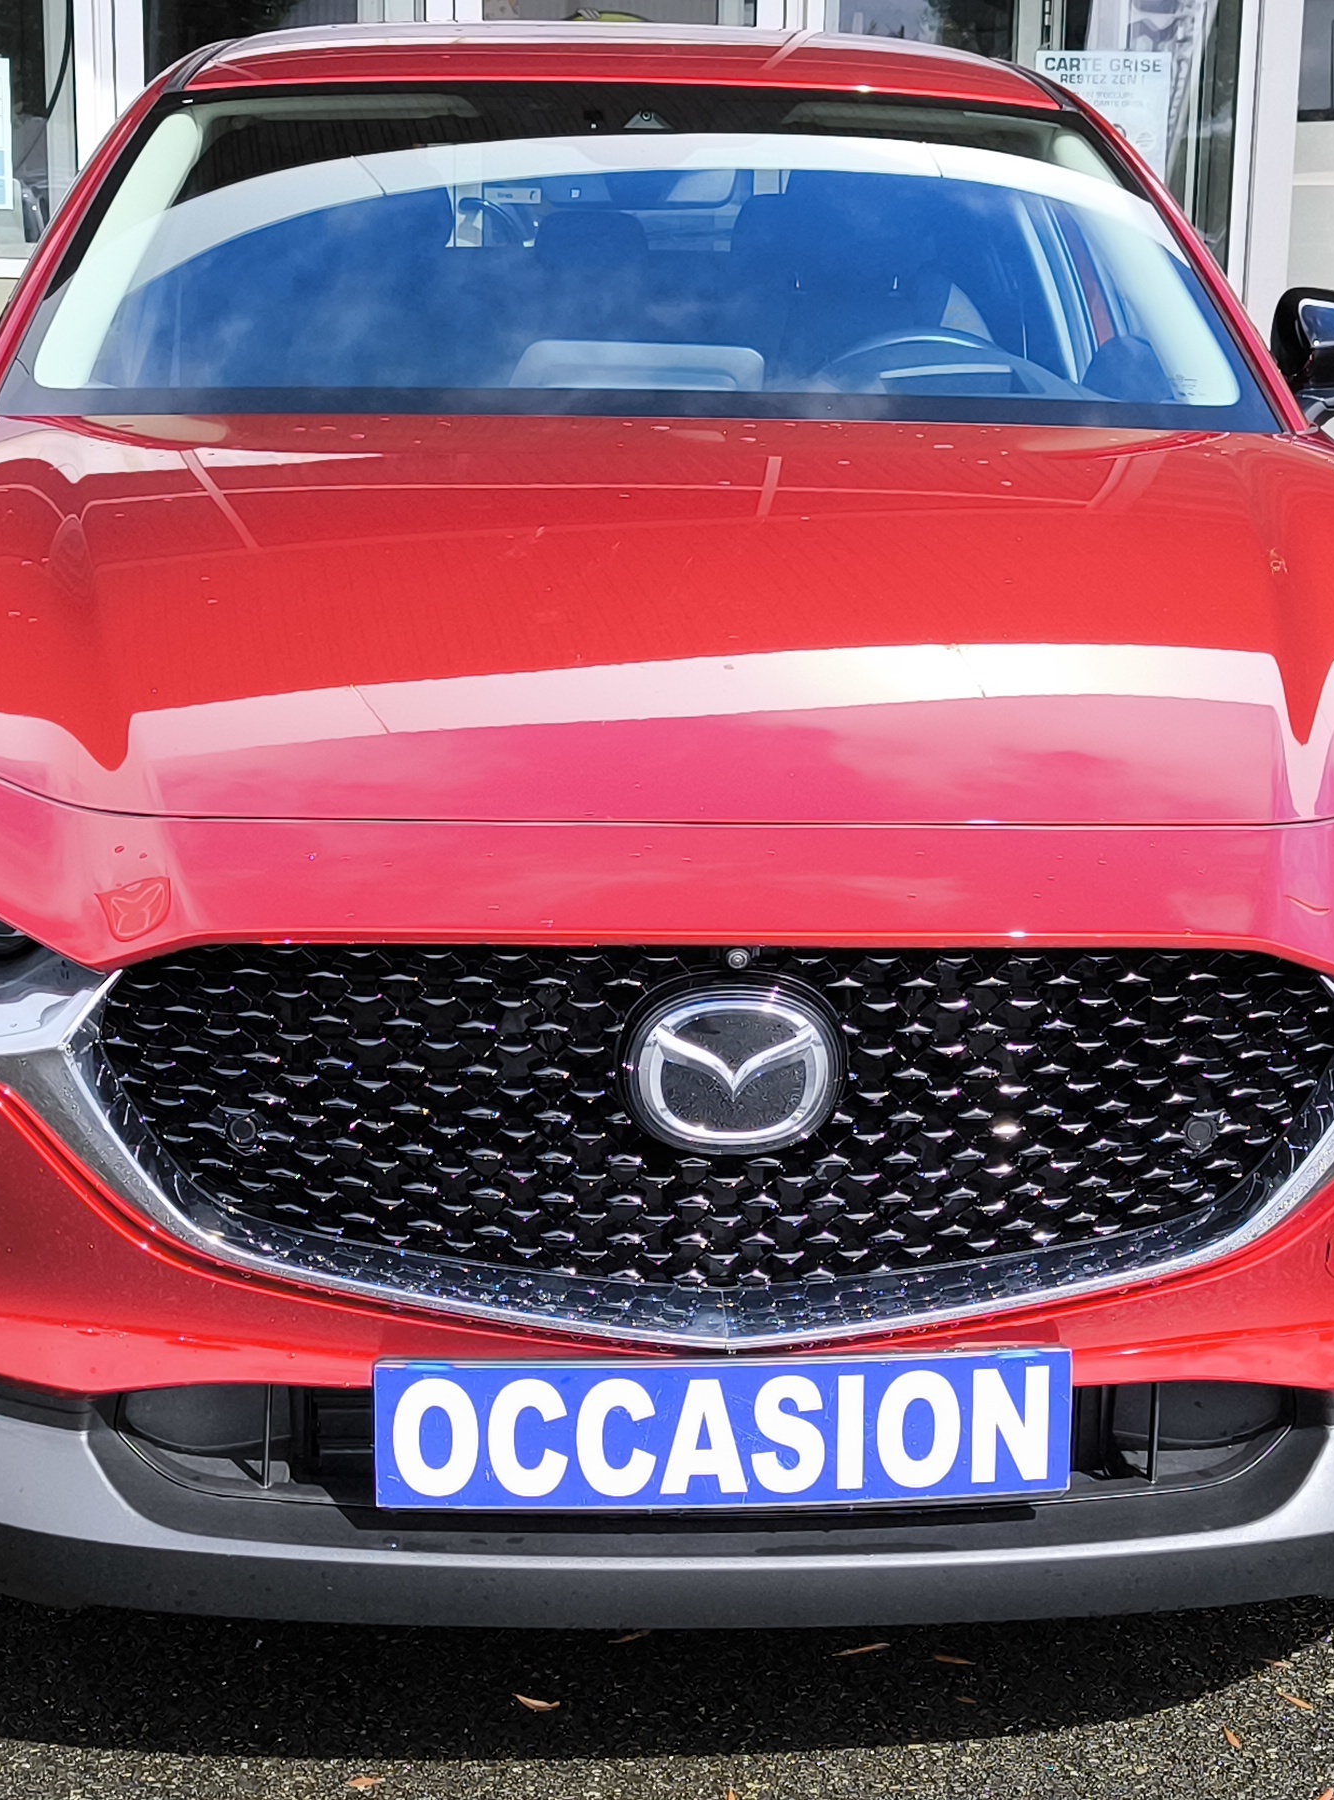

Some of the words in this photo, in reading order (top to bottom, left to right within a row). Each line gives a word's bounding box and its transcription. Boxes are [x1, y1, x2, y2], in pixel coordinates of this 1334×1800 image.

[1044, 57, 1102, 72] CARTE
[1108, 58, 1162, 73] GRISE
[1111, 74, 1136, 85] ZEN
[392, 1365, 1051, 1498] OCCASION
